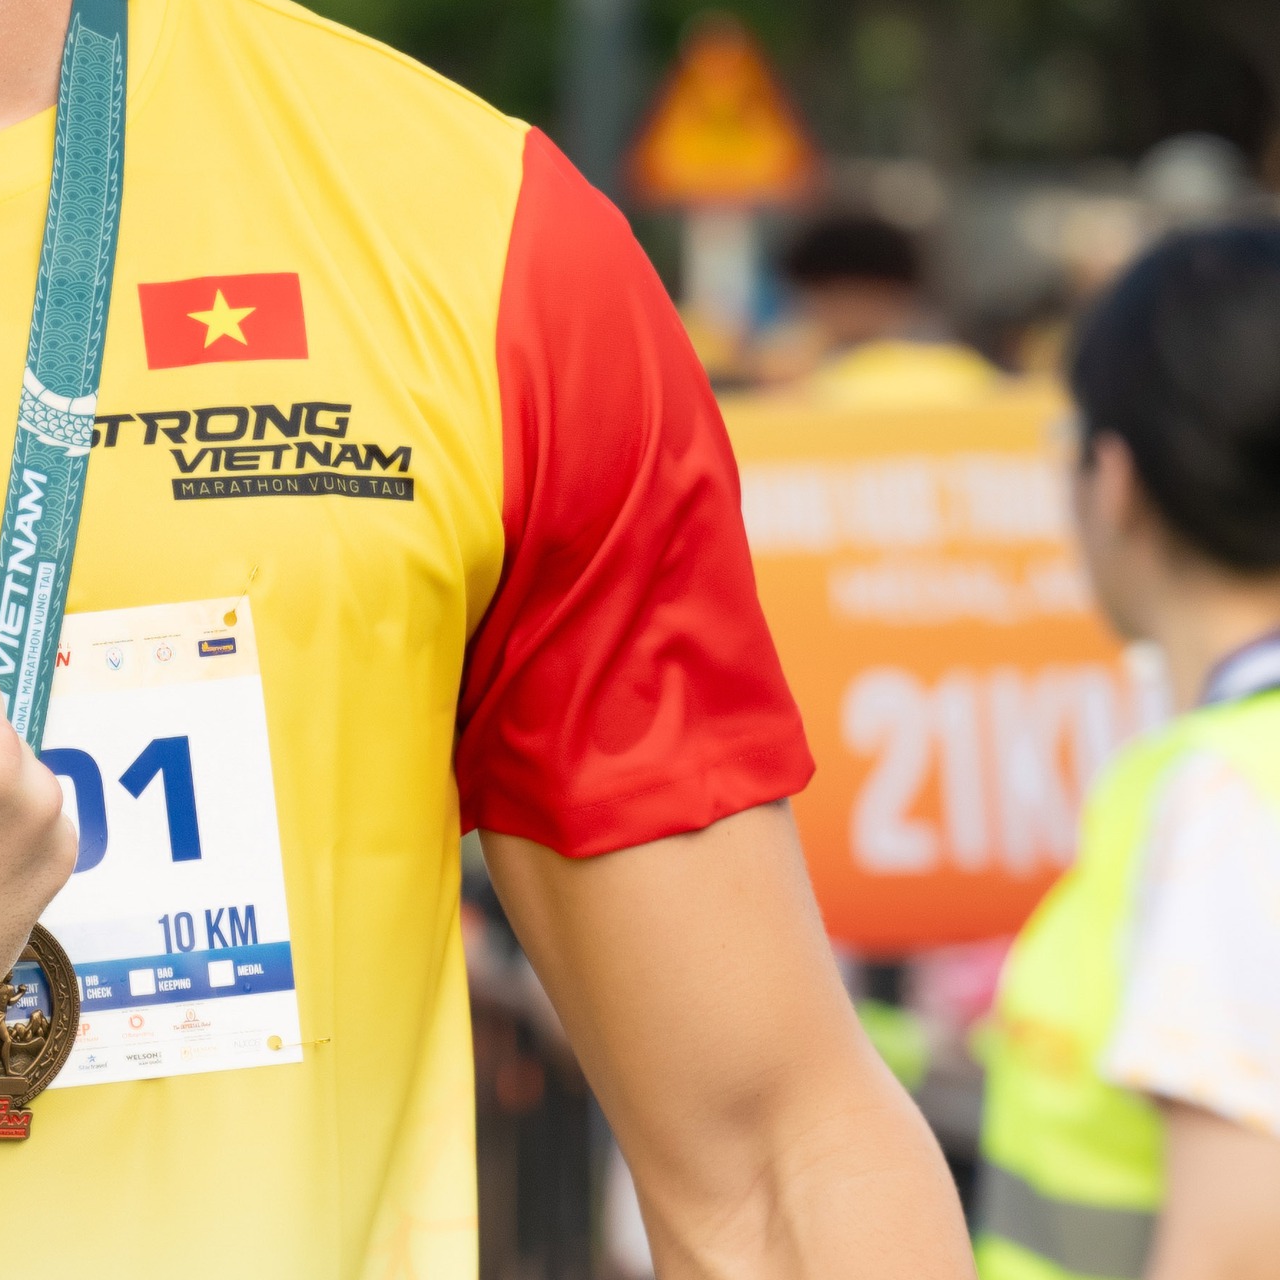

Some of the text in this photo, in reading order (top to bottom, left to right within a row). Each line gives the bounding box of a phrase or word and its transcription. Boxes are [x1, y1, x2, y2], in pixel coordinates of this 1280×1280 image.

[170, 442, 412, 473] VIETNAM
[182, 477, 407, 497] MARATHON VUNG TAU
[39, 566, 54, 590] TAU
[34, 593, 48, 627] VUNG
[22, 628, 43, 695] MARATHON
[158, 904, 258, 954] 10 KM
[157, 967, 173, 979] BAG
[237, 963, 264, 977] MEDAL
[85, 974, 100, 987] BIB
[158, 978, 191, 992] KEEPING
[87, 987, 112, 1000] CHECK
